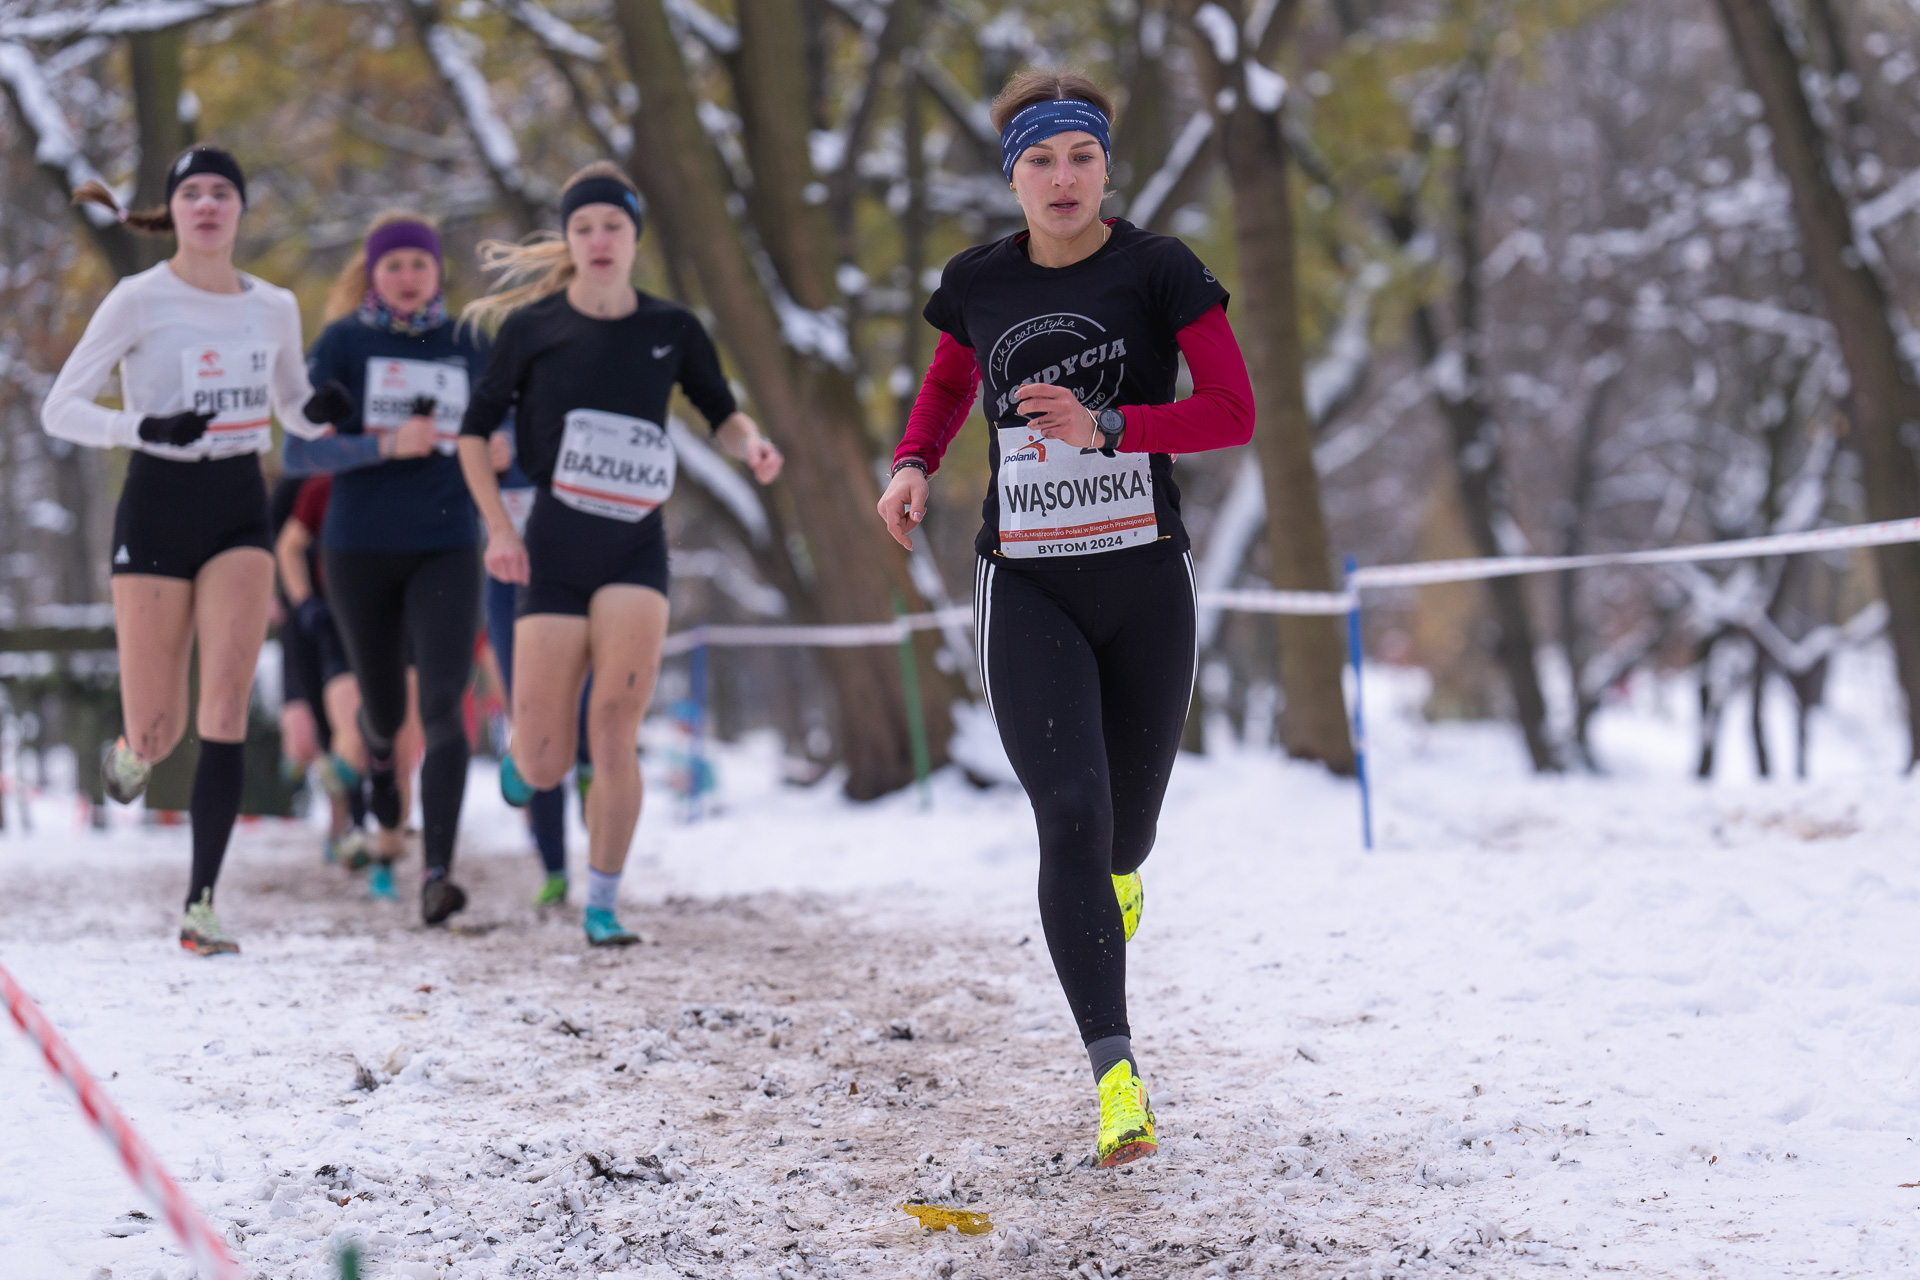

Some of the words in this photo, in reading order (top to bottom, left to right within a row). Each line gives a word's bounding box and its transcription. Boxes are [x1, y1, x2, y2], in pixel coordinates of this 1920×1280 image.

[1003, 450, 1037, 465] polanik
[563, 449, 668, 488] BAZUŁKA
[1004, 469, 1147, 518] WĄSOWSKA
[1029, 529, 1065, 538] Mistrzostwa
[1065, 527, 1083, 535] Polski
[1037, 541, 1087, 554] BYTOM
[1090, 535, 1124, 550] 2024
